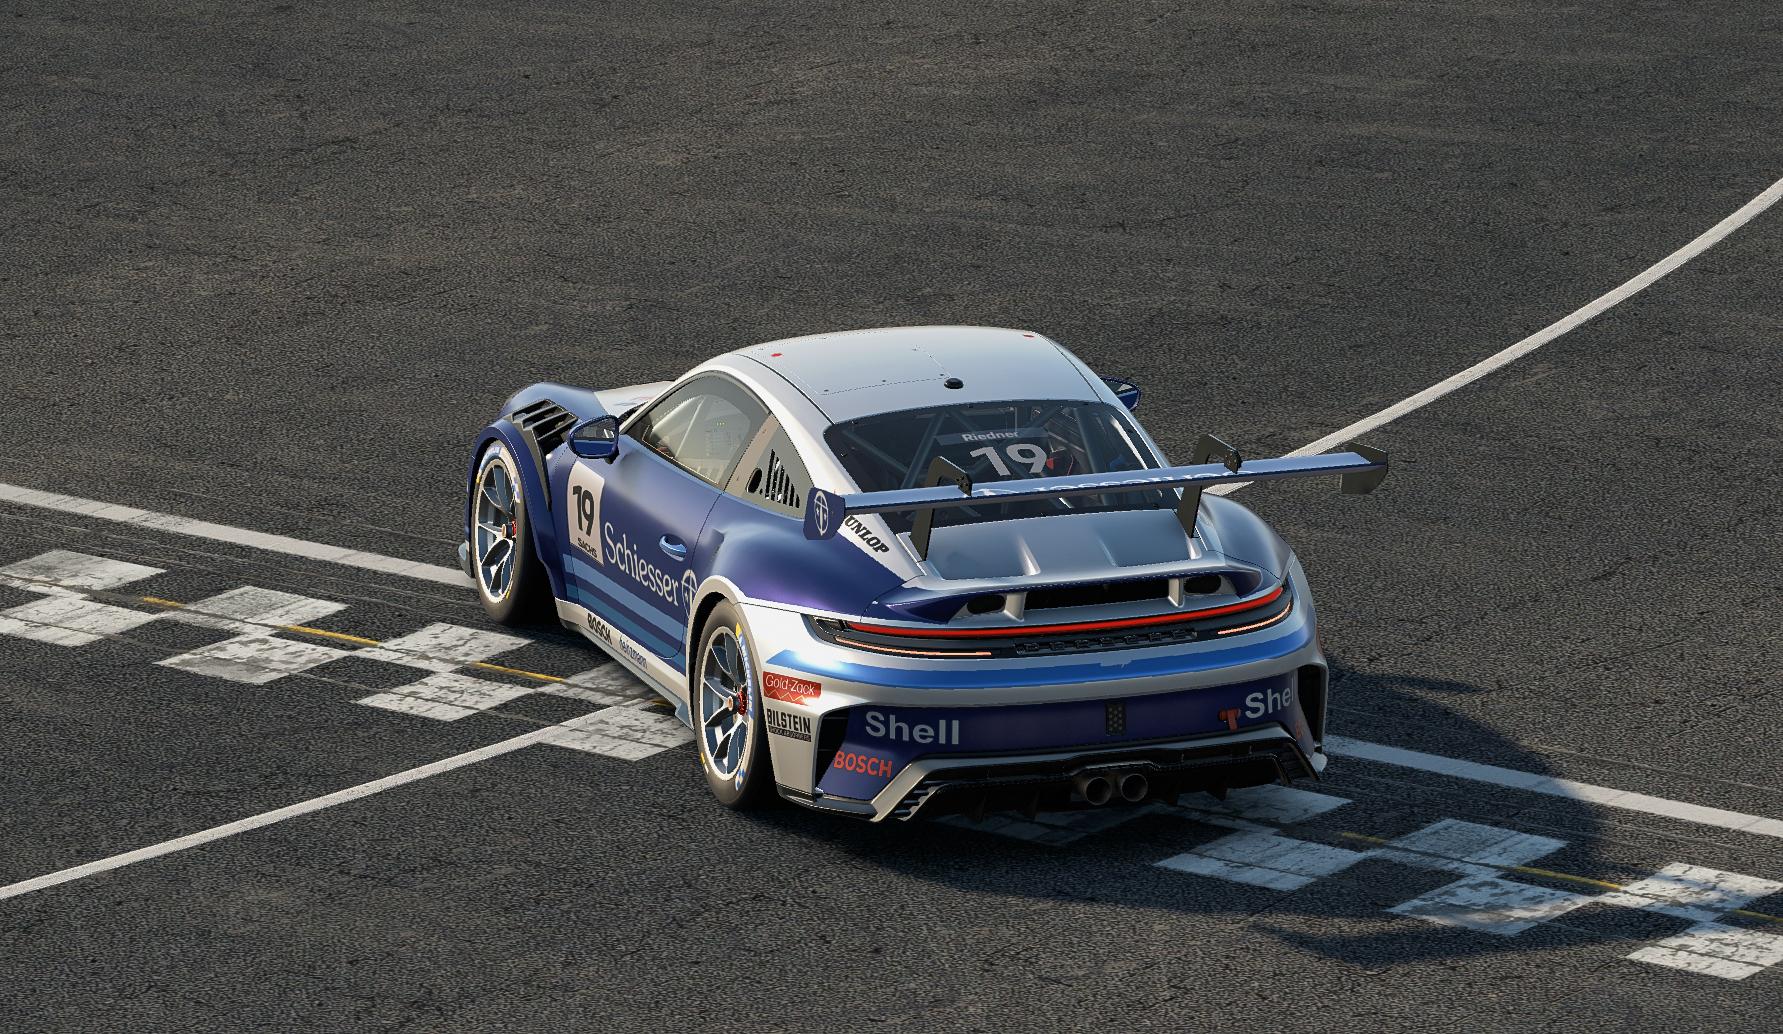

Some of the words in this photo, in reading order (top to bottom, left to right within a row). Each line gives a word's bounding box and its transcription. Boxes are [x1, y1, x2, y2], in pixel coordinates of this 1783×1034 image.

[961, 431, 1019, 442] Riedner
[969, 443, 1048, 477] 19
[572, 485, 595, 537] 19
[844, 515, 890, 553] UNLOP
[604, 521, 679, 607] Schiesser
[587, 612, 613, 646] BOSCH
[765, 674, 815, 696] Gold-Zack
[1245, 676, 1295, 719] Shel
[766, 708, 811, 733] BILSTEIN
[865, 711, 960, 745] Shell
[833, 750, 893, 779] BOSCH
